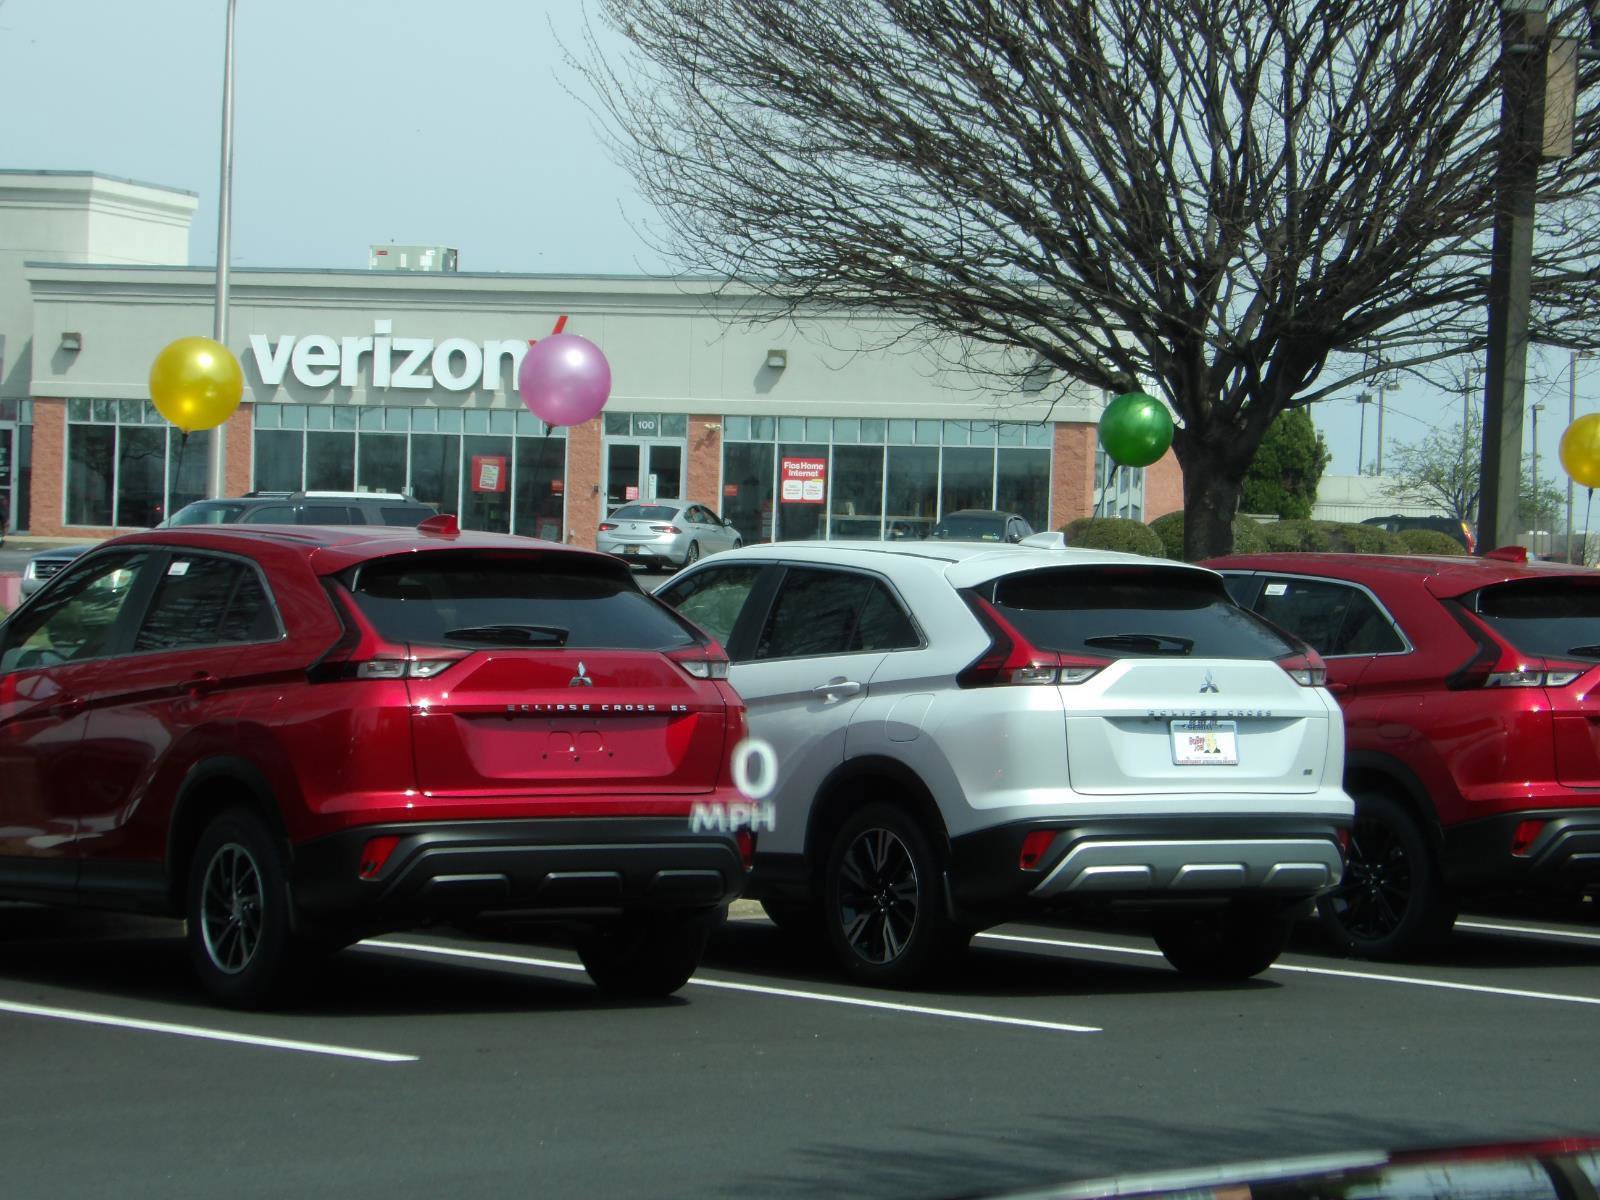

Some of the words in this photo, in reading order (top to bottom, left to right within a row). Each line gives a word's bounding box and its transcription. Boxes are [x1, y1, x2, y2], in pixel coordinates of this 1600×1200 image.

[249, 319, 528, 391] verizon
[638, 421, 655, 430] 100
[784, 461, 800, 469] Fios
[800, 462, 824, 470] Home
[788, 469, 819, 477] Internet
[731, 738, 778, 799] 0
[689, 802, 776, 833] MPH
